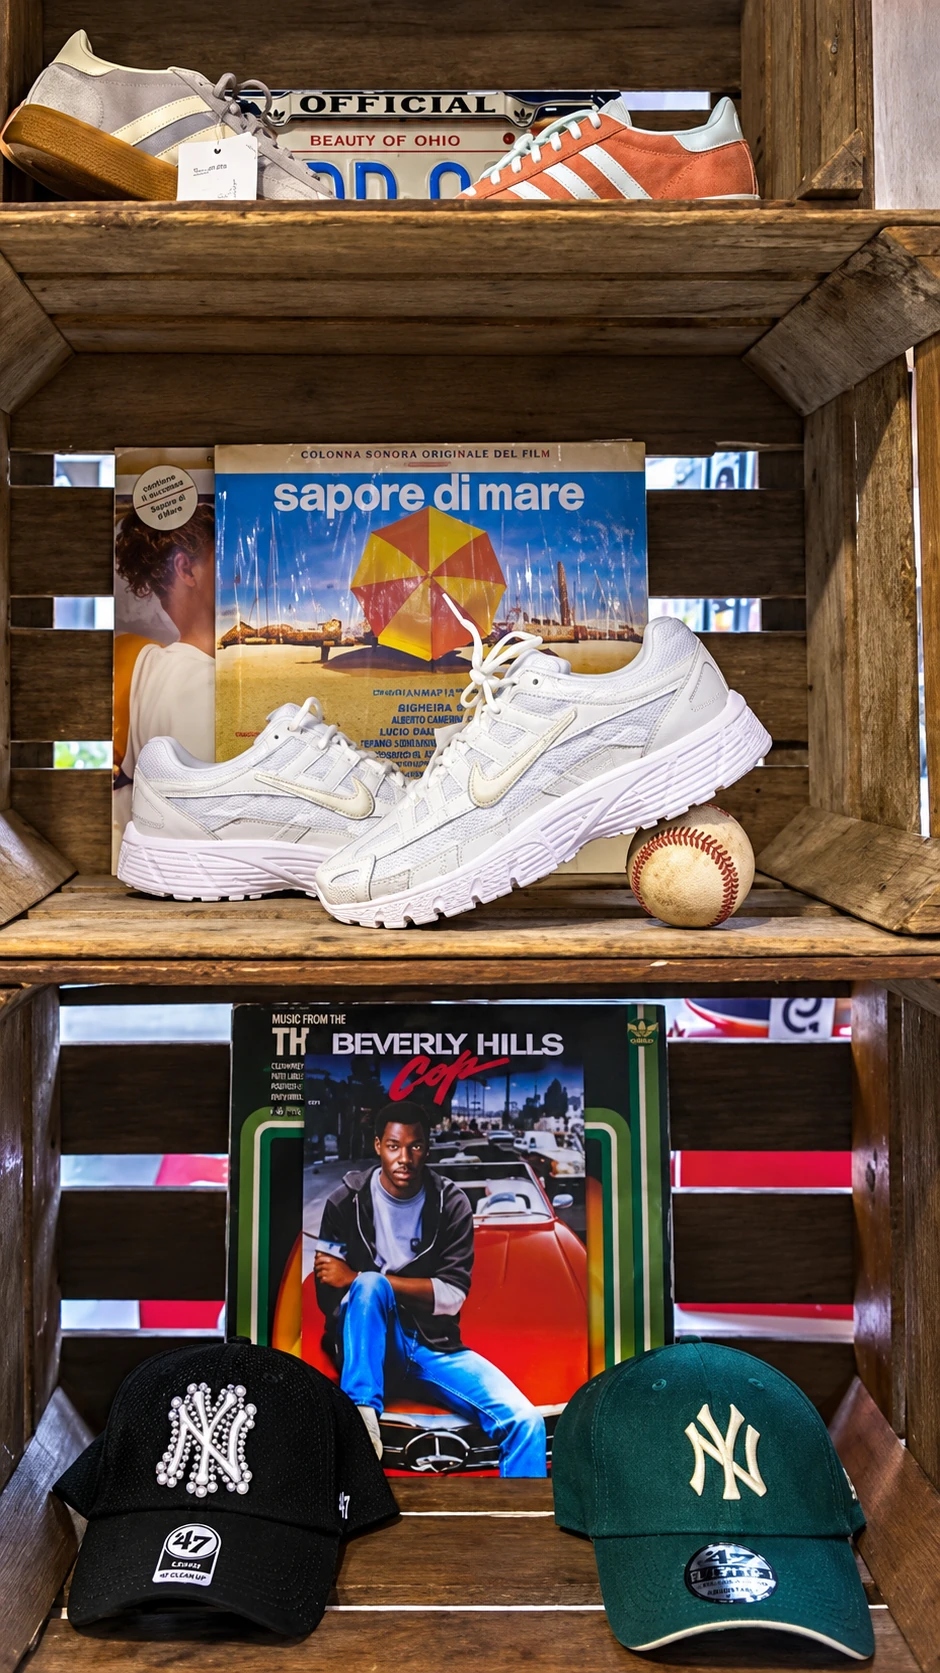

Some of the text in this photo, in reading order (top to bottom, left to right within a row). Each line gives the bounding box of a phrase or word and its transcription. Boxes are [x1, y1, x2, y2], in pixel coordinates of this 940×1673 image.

[299, 95, 497, 114] OFFICIAL
[310, 134, 461, 147] BEAUTY OF OHIO
[300, 449, 551, 459] COLONNA SONORA ORIGINALE DEL FILM
[273, 473, 585, 519] sapore di mare
[379, 727, 410, 737] LUCIO
[271, 1013, 347, 1025] MUSIC FROM THE
[331, 1032, 565, 1057] BEVERLY HILLS
[388, 1049, 511, 1106] Cop
[157, 1382, 257, 1498] NY
[684, 1403, 768, 1500] NY
